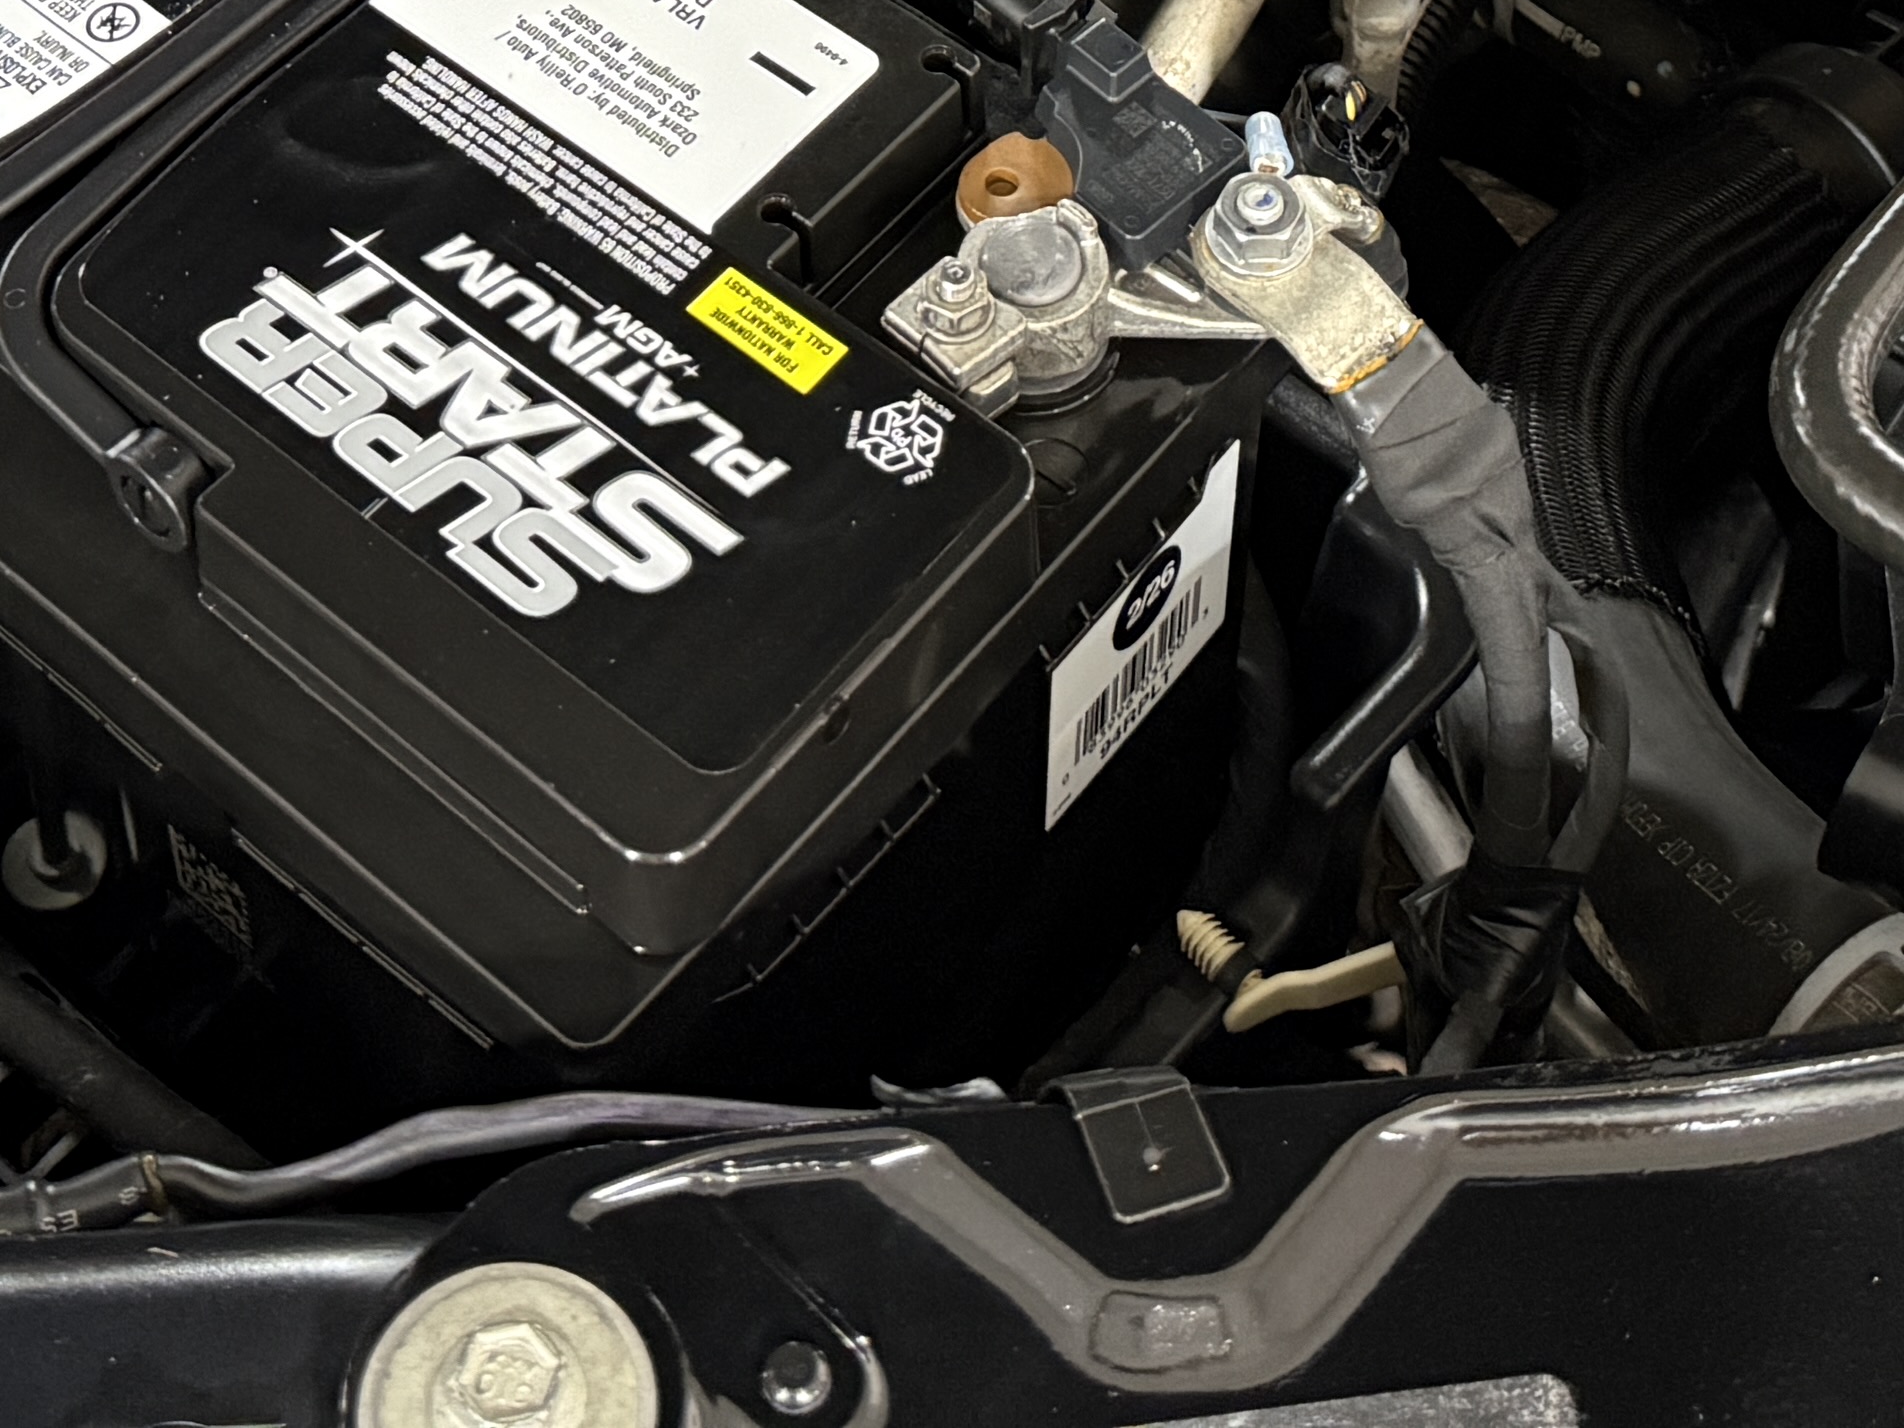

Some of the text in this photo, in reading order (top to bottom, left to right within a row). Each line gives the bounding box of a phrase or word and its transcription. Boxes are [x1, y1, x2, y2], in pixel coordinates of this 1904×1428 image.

[48, 0, 82, 23] KEEP
[14, 42, 53, 71] CAUSE
[45, 65, 73, 87] CAN
[68, 56, 90, 74] OR
[553, 4, 702, 102] Springfield, MO 65802
[573, 34, 640, 82] Patterson
[494, 30, 687, 158] Distributed by: O'Reilly Auto /
[509, 14, 698, 146] Ozark Automotive Distributors,
[633, 70, 673, 106] South
[669, 95, 700, 123] 233
[709, 307, 800, 374] FOR NATIONWIDE
[735, 306, 796, 351] WARRANTY
[805, 332, 834, 356] CALL
[421, 234, 791, 498] PLATINUM
[252, 261, 746, 594] START
[200, 302, 579, 618] SUPER
[1124, 558, 1178, 628] 2/26
